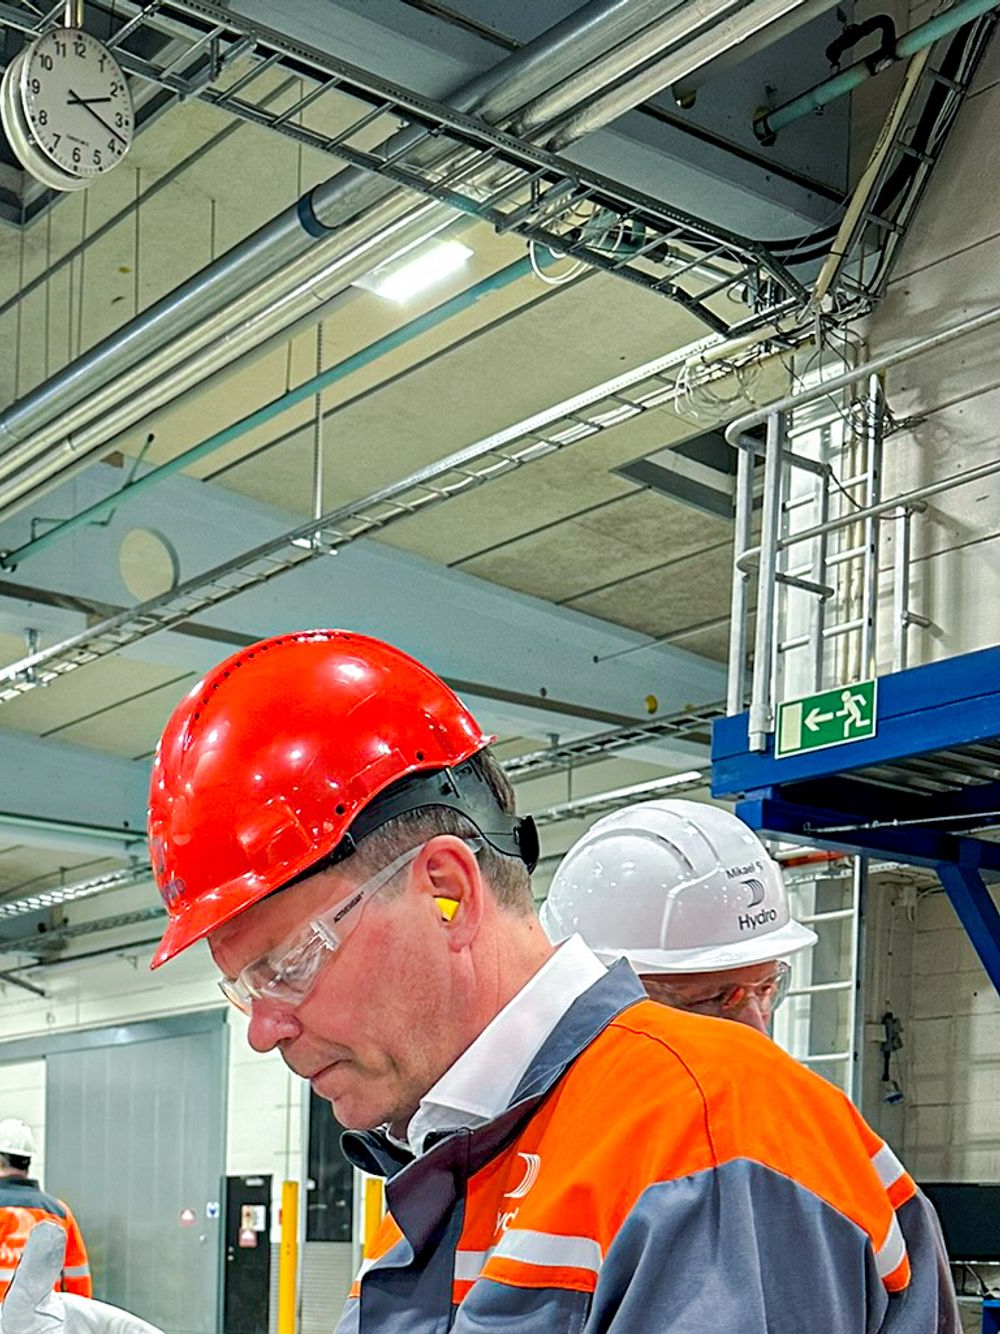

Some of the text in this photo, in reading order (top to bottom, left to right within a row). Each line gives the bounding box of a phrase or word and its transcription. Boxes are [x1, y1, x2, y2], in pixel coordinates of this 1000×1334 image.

[55, 41, 66, 57] 11
[73, 41, 86, 59] 12
[39, 54, 53, 71] 10
[99, 59, 104, 72] 1
[32, 78, 40, 94] 9
[110, 82, 118, 97] 2
[39, 110, 47, 125] 8
[115, 112, 123, 128] 3
[52, 133, 60, 148] 7
[107, 139, 115, 153] 4
[72, 147, 80, 162] 6
[93, 149, 101, 165] 5
[726, 863, 755, 879] Mikael
[738, 909, 777, 930] Hydro
